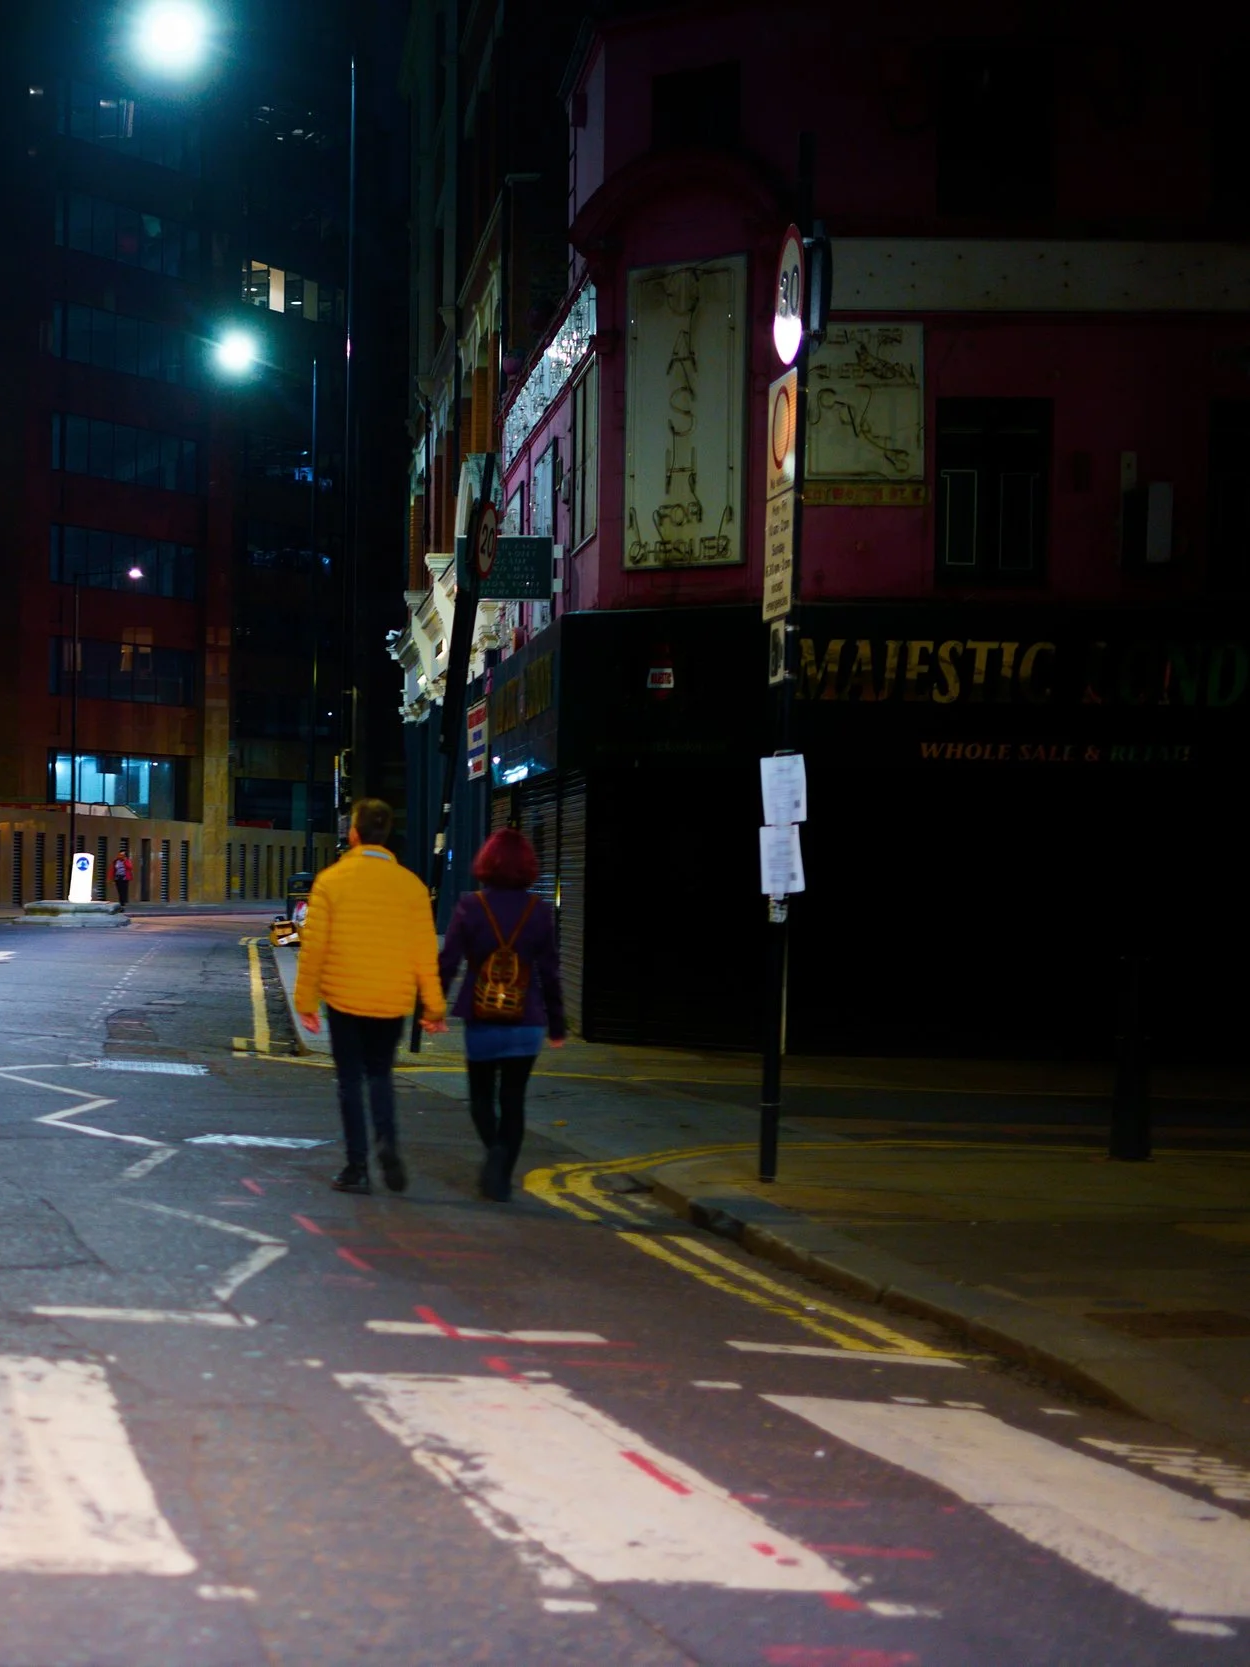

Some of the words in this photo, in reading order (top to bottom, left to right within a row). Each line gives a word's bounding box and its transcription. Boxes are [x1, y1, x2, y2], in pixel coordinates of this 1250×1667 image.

[779, 264, 800, 317] 30
[480, 523, 495, 558] 20
[793, 637, 1057, 704] MAJESTIC
[920, 741, 1011, 761] WHOLE
[1018, 743, 1078, 762] SALE
[1083, 743, 1102, 763] &
